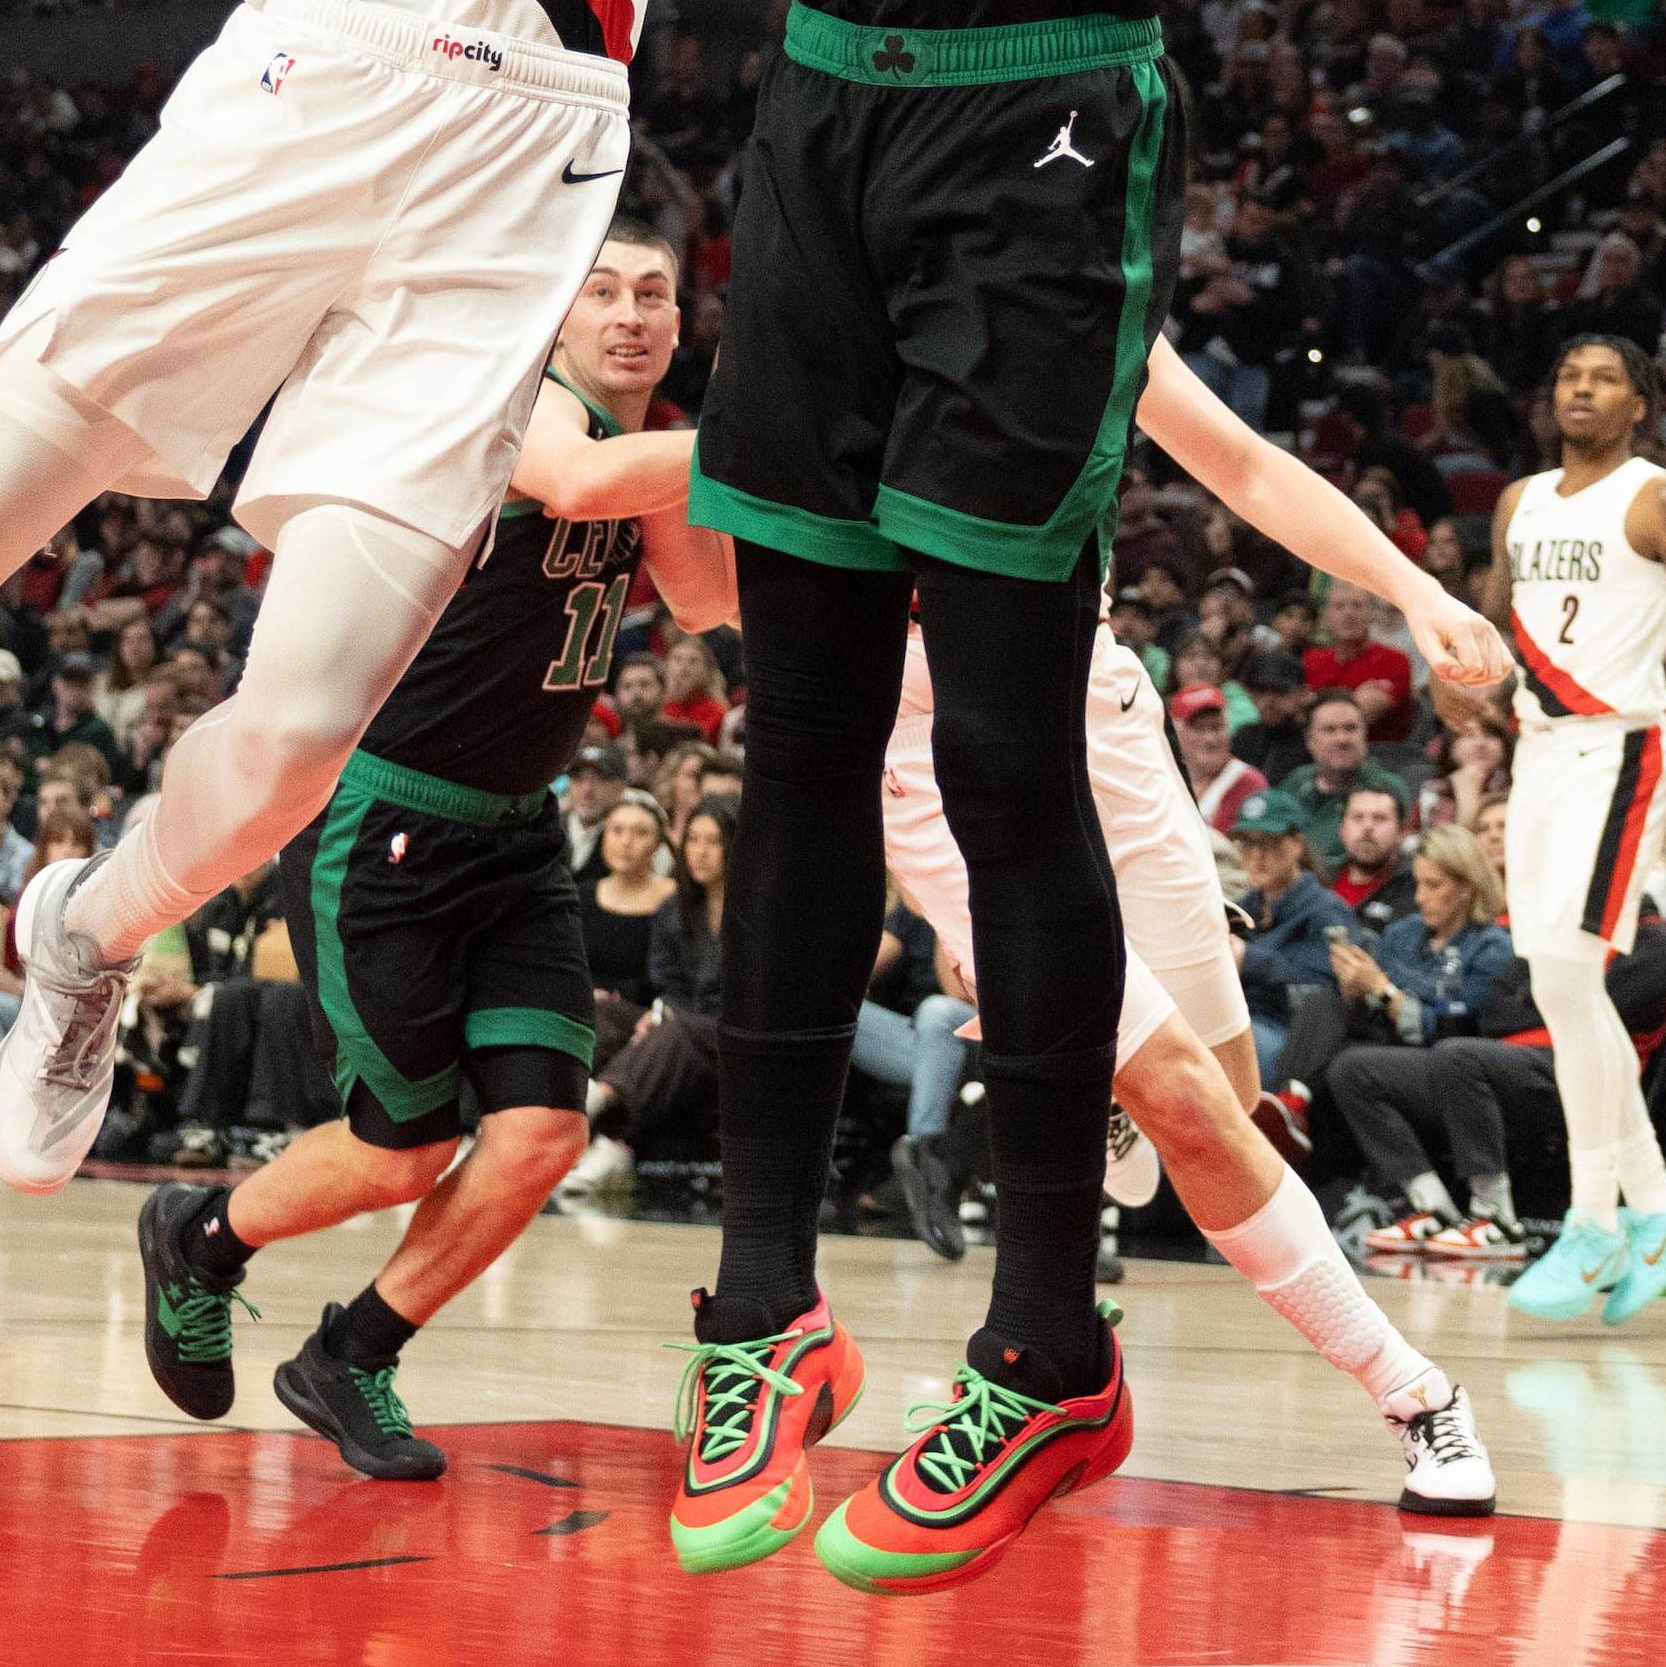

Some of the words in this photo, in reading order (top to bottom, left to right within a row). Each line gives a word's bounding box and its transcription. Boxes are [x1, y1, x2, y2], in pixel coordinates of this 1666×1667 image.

[432, 34, 502, 71] ripcity
[542, 573, 630, 691] 11
[1559, 594, 1579, 644] 2
